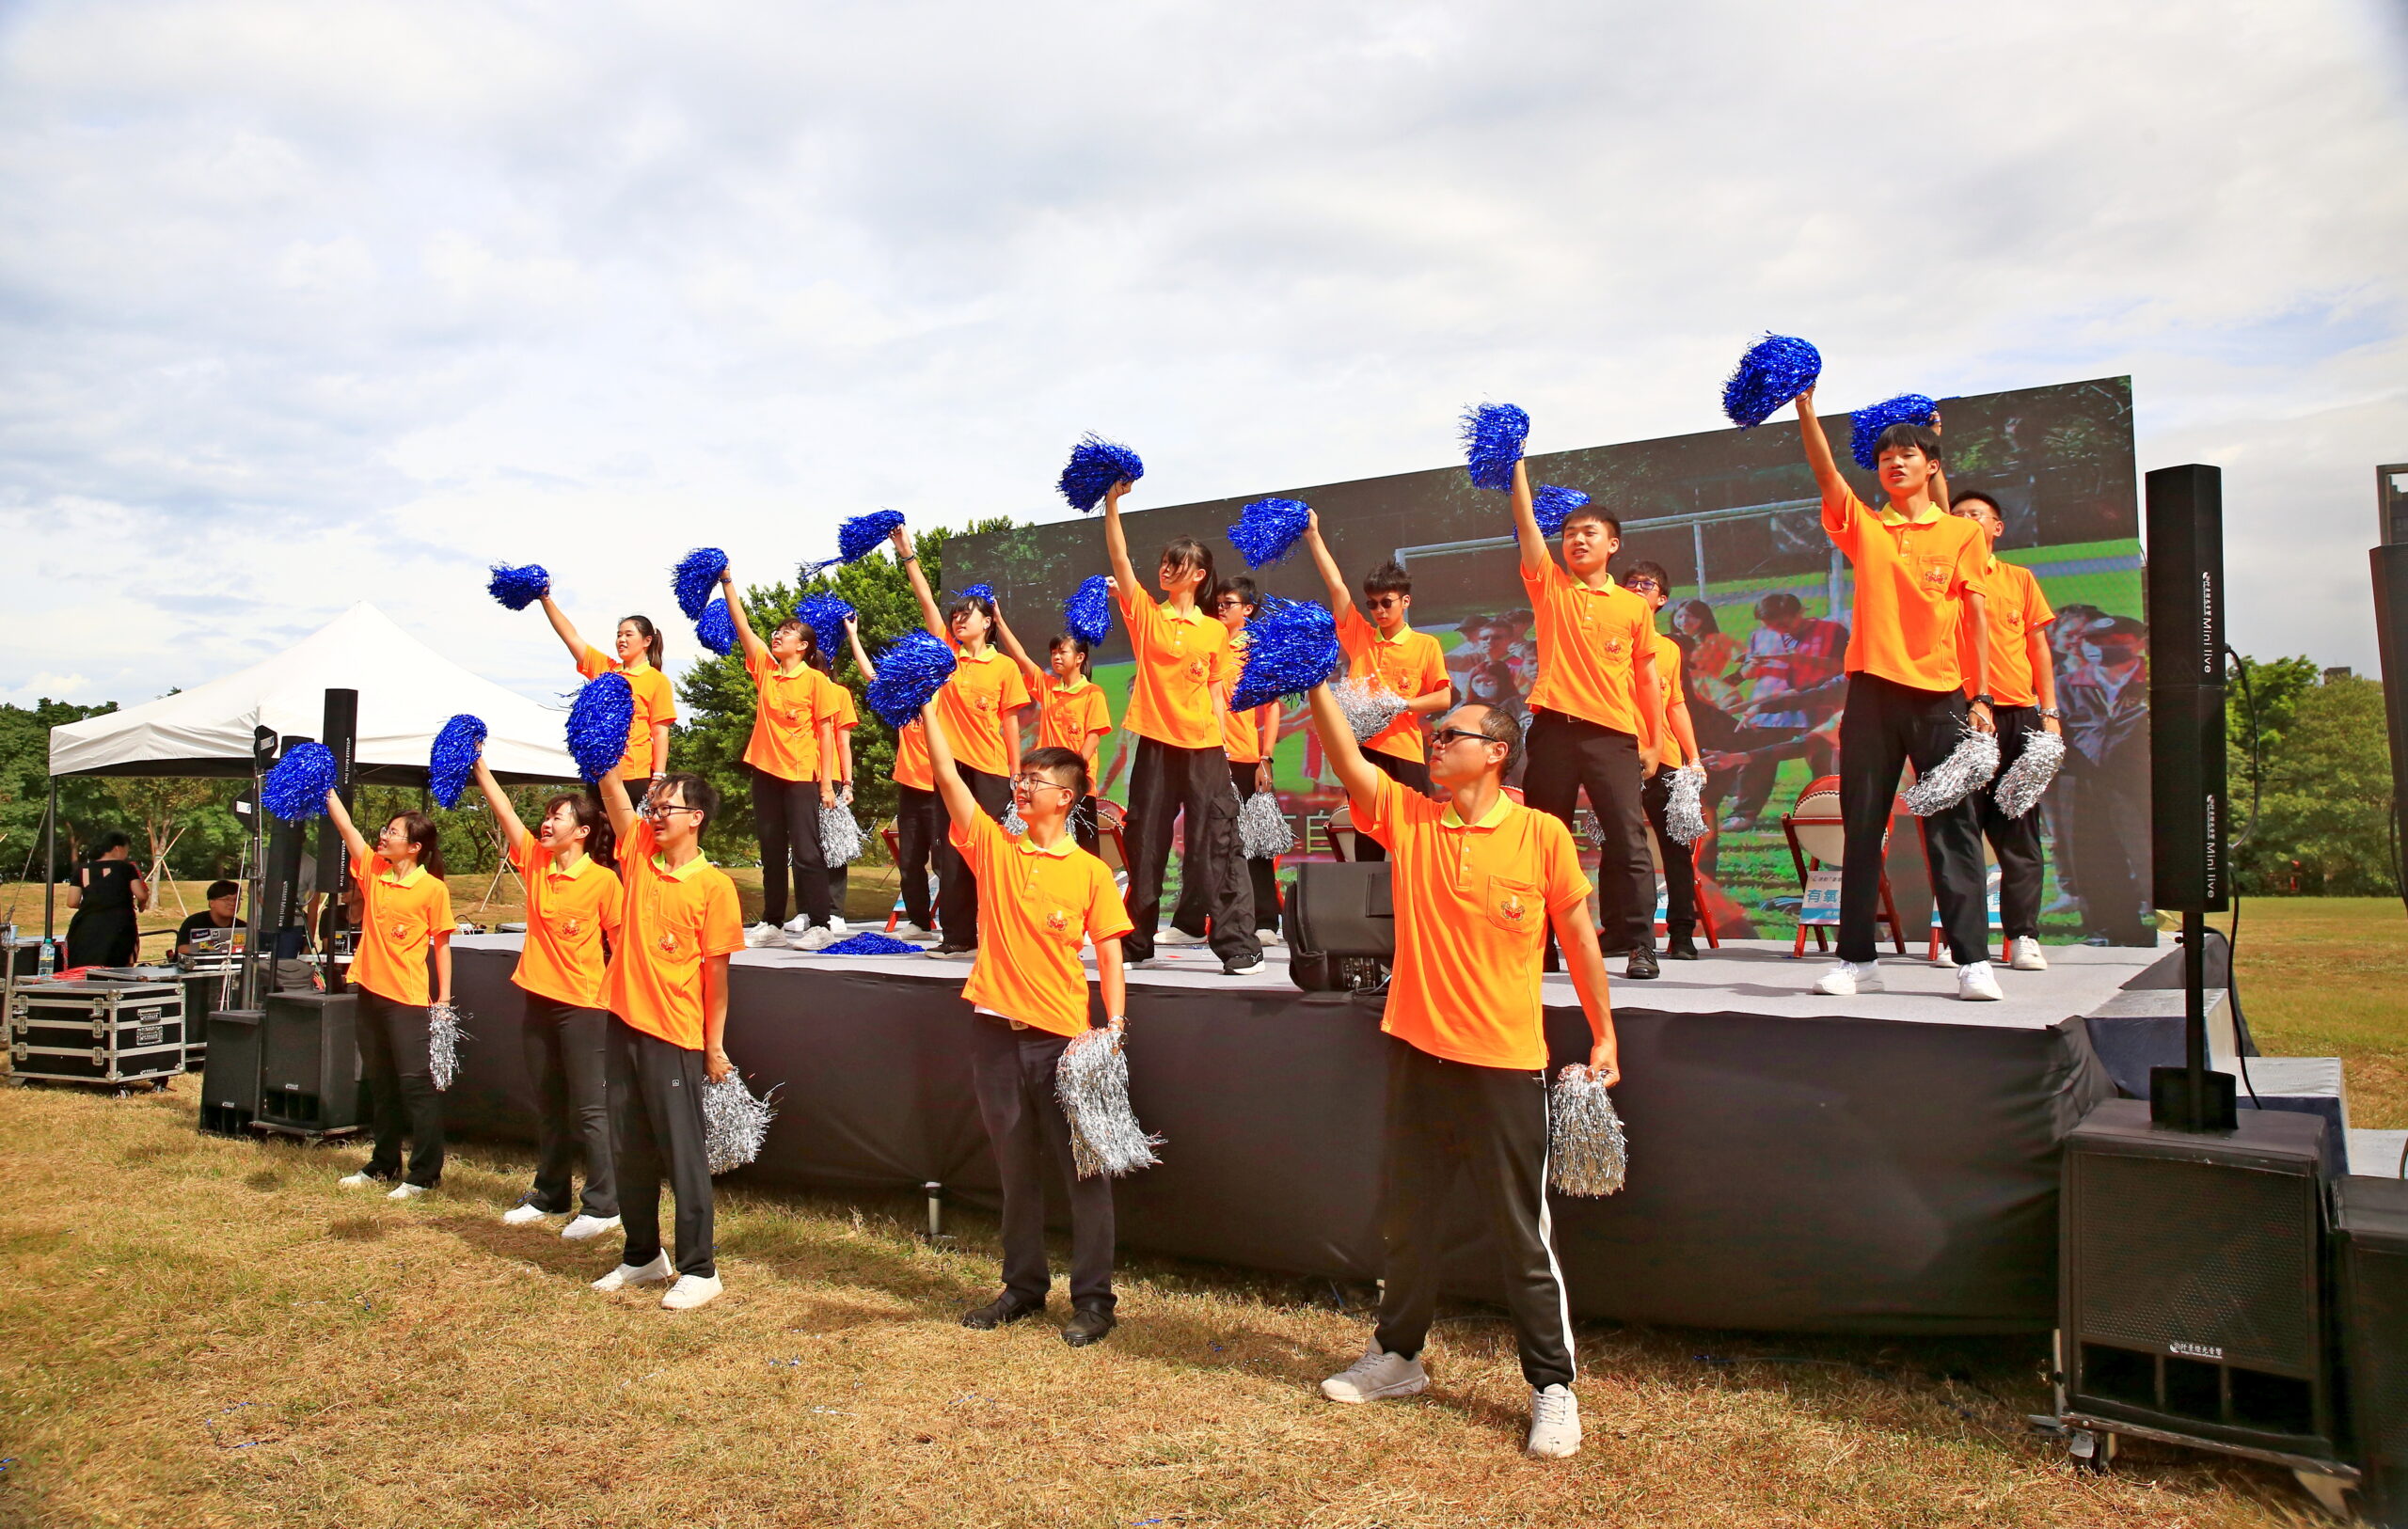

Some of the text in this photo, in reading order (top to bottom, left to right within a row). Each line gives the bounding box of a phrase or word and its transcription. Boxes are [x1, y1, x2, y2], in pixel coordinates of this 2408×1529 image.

[2203, 617, 2212, 646] Mini
[2203, 649, 2212, 673] live
[2206, 842, 2216, 871] Mini
[2207, 874, 2216, 898] live
